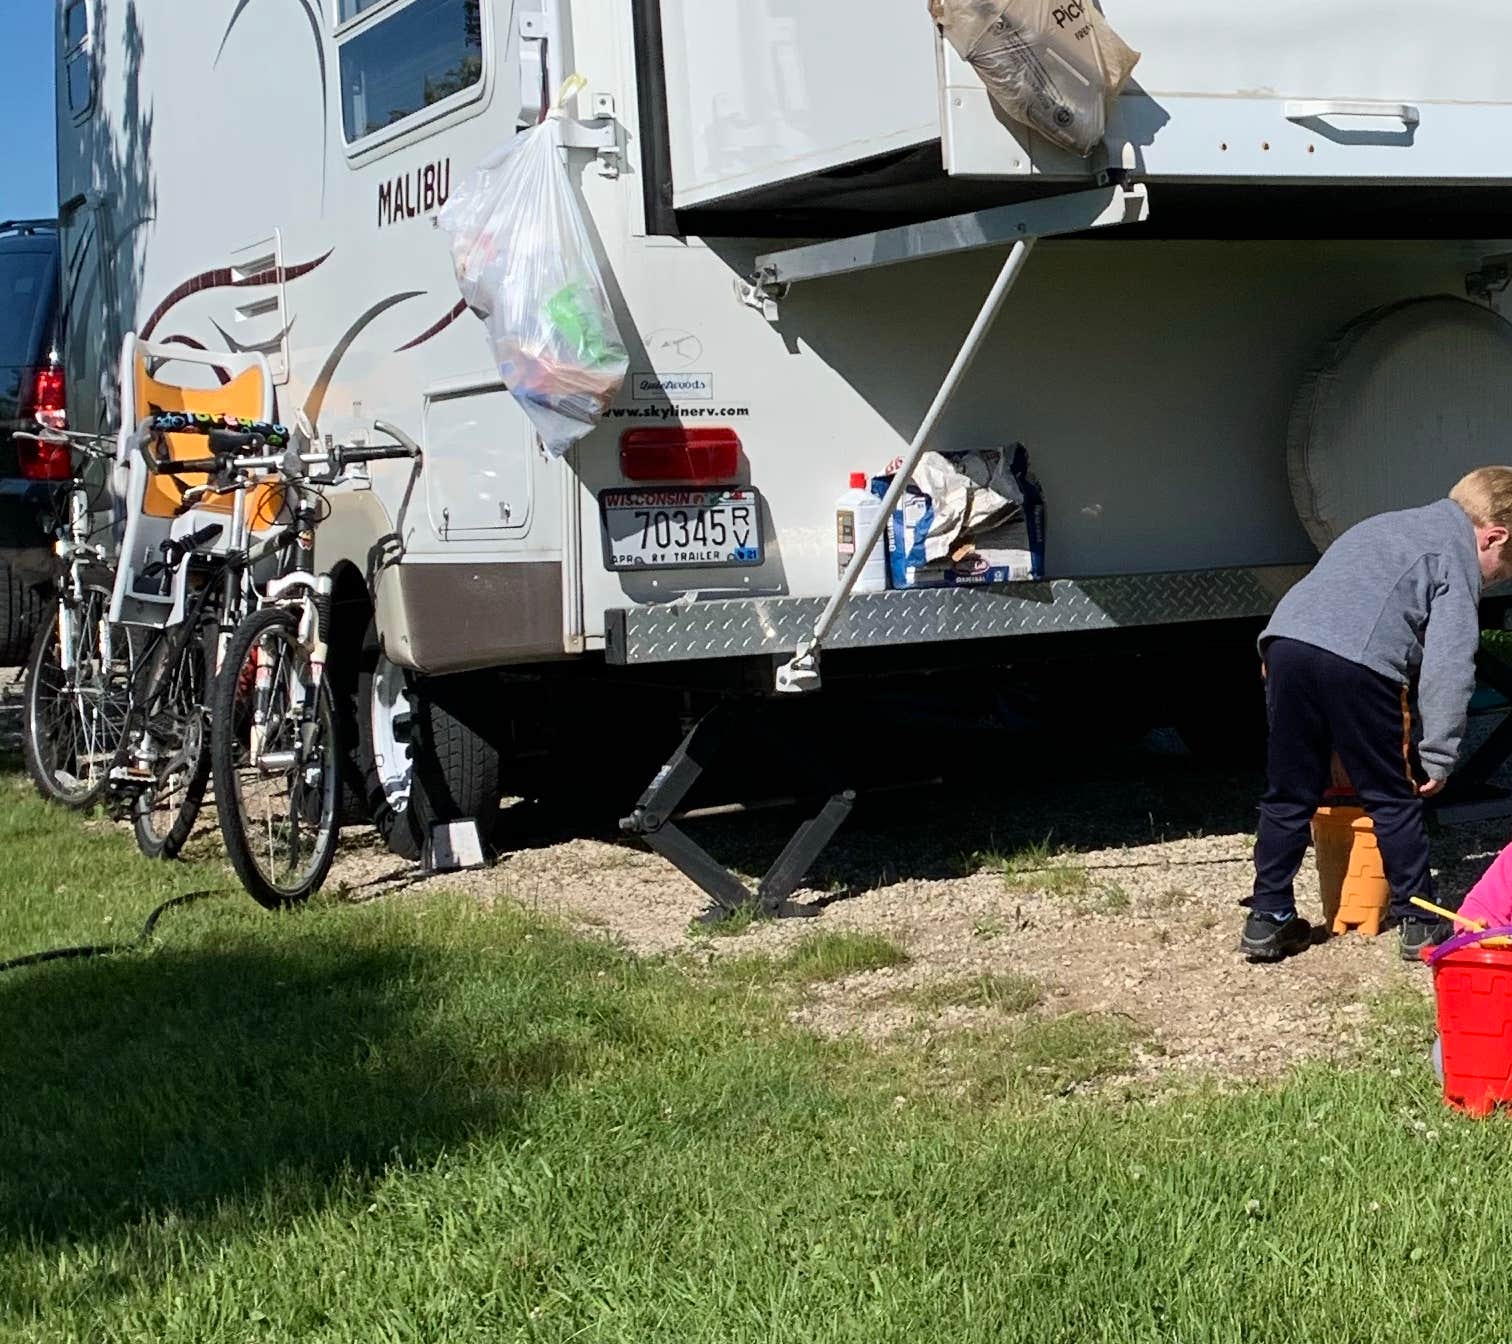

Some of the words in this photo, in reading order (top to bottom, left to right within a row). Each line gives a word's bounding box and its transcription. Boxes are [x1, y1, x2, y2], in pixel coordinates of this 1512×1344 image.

[377, 157, 450, 227] MALIBU
[606, 493, 690, 507] WISCONSIN
[634, 508, 727, 550] 70345
[674, 550, 721, 561] TRAILER
